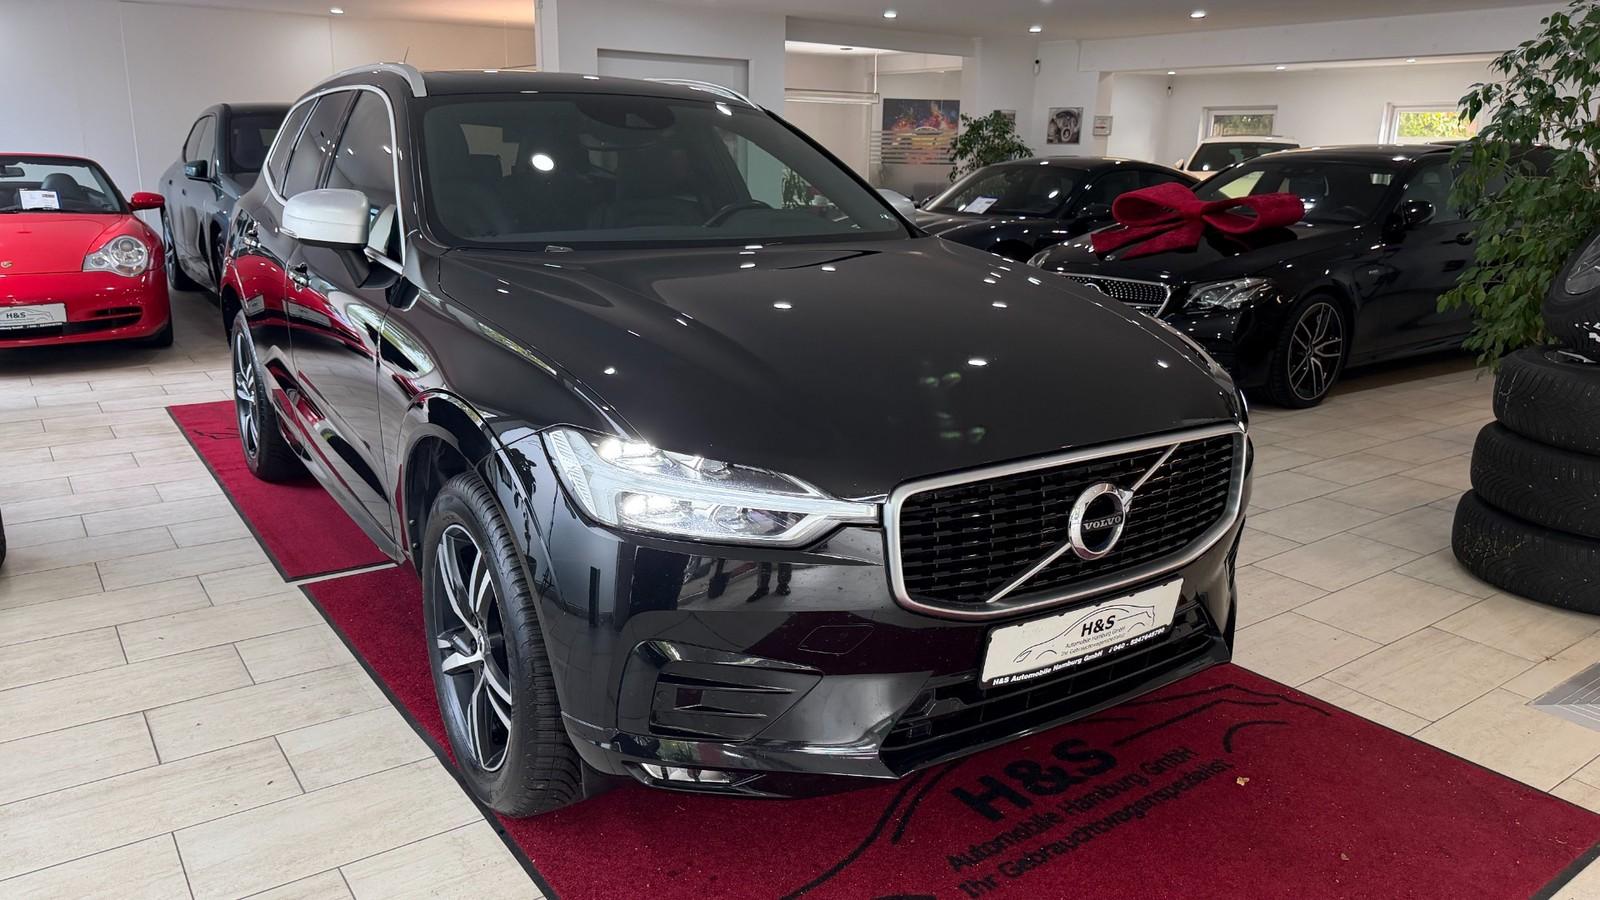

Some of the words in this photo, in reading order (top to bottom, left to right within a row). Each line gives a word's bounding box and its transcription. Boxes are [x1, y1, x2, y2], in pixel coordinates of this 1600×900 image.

[1083, 515, 1121, 530] VOLVO
[1081, 615, 1115, 637] H&S
[992, 676, 1010, 686] H&S
[1010, 667, 1052, 682] Automobile
[1052, 657, 1083, 671] Hamburg
[1083, 650, 1103, 662] GmbH
[950, 738, 1117, 823] H&S
[946, 810, 1064, 872] Automobile
[1058, 771, 1148, 816] Hamburg
[1140, 746, 1201, 775] GmbH
[959, 872, 998, 899] Ihr
